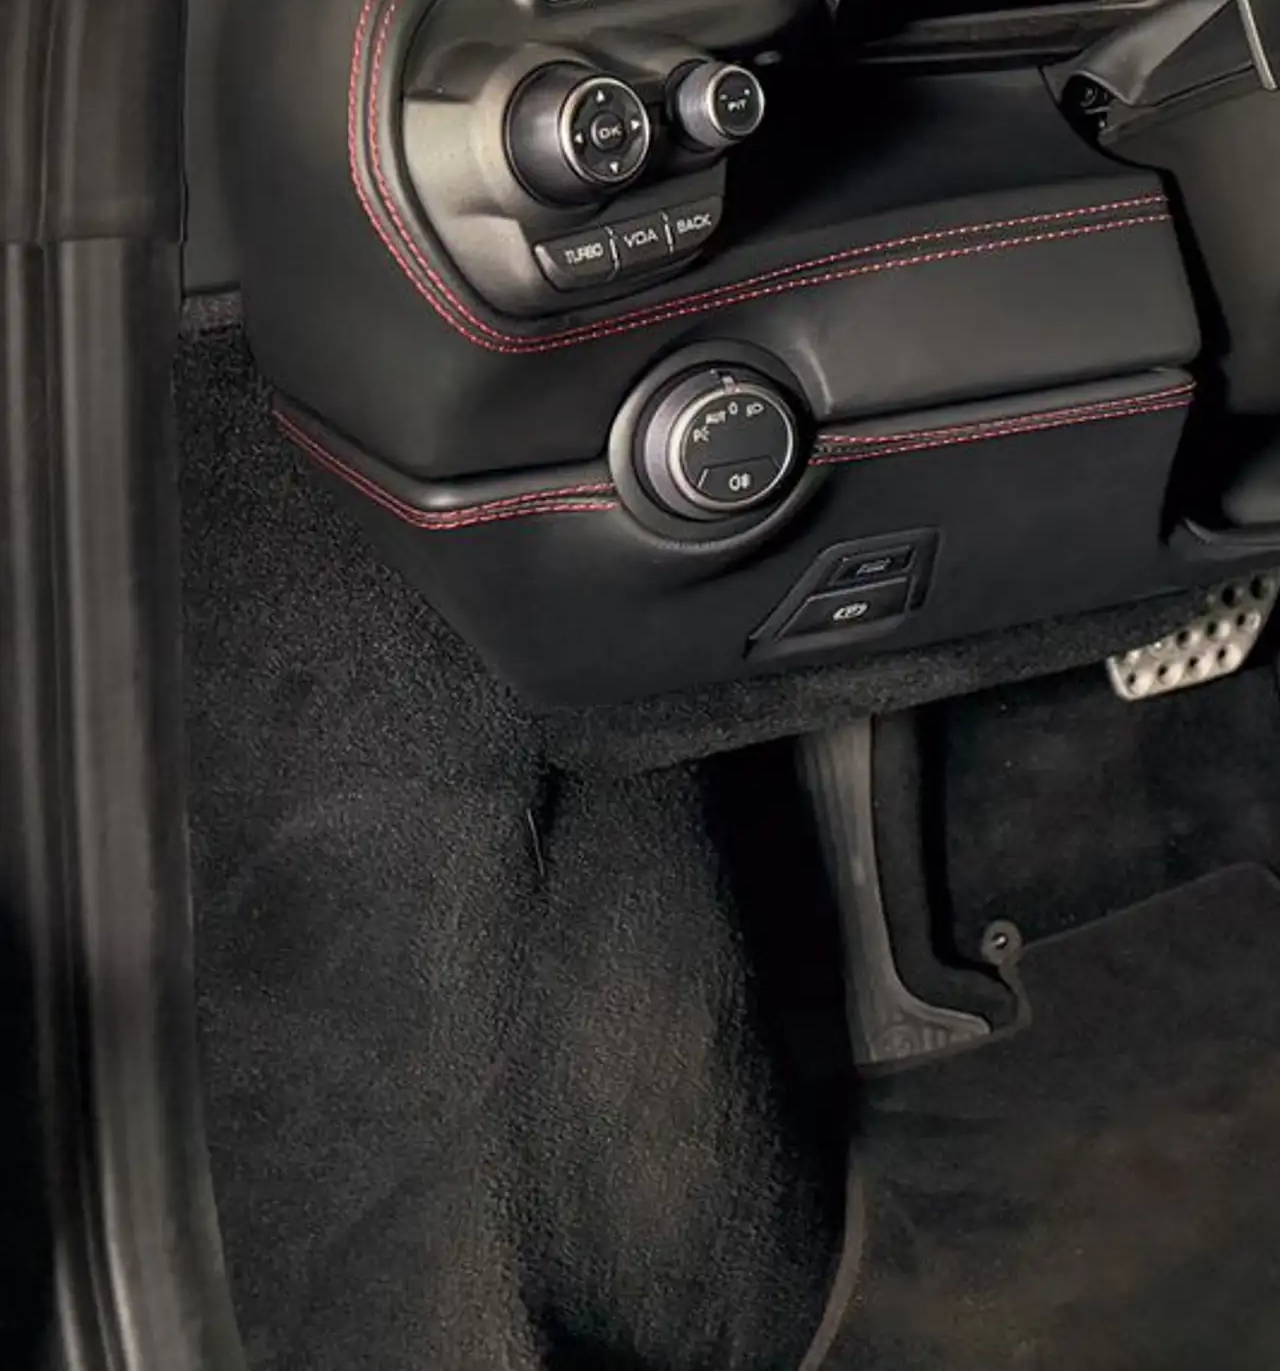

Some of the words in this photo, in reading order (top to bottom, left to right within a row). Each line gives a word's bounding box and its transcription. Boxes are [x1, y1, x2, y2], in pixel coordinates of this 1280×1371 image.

[599, 125, 622, 140] OK
[676, 213, 712, 233] BACK
[623, 228, 659, 249] VDA
[564, 243, 604, 265] TURBO
